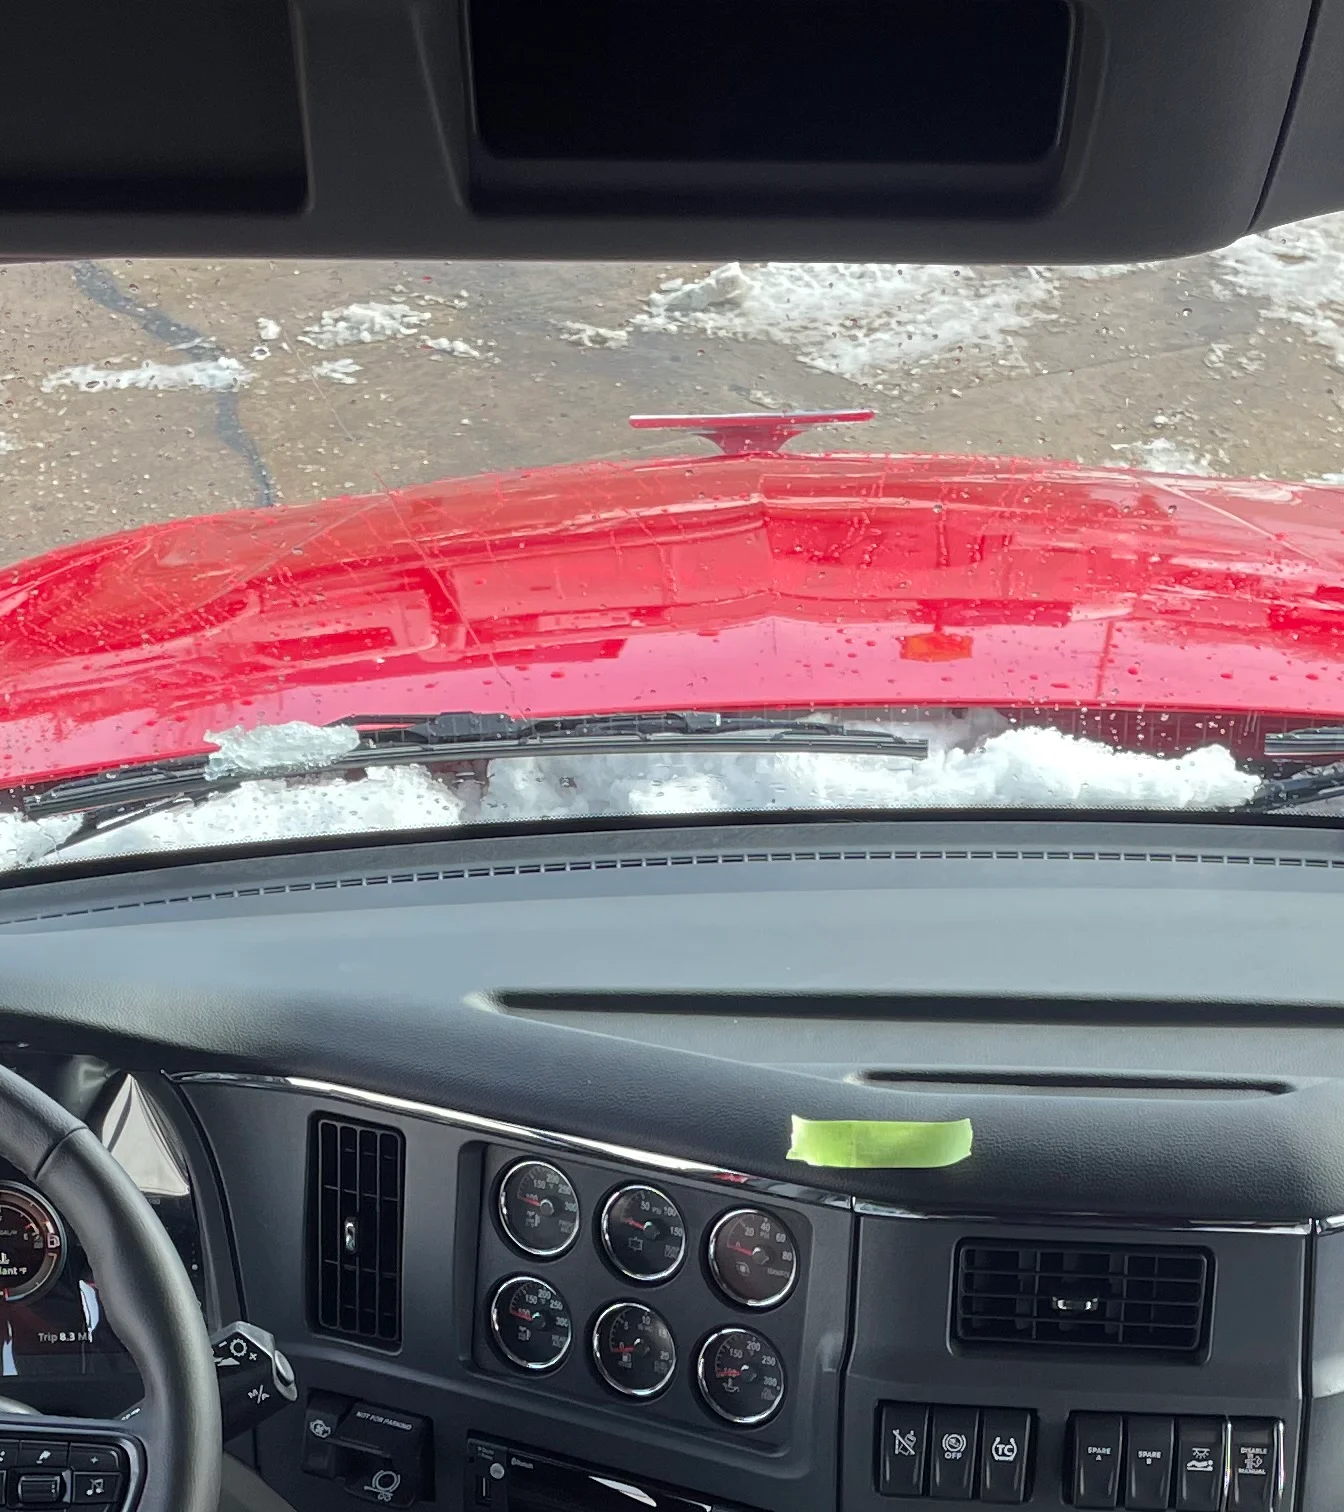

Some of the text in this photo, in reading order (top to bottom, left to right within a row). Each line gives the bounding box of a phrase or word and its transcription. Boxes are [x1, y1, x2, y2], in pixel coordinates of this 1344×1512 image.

[641, 1201, 650, 1211] 50
[745, 1227, 754, 1236] 20
[761, 1222, 770, 1232] 40
[776, 1233, 786, 1242] 60
[782, 1251, 792, 1261] 80
[550, 1300, 563, 1310] 250
[37, 1332, 58, 1342] Trip
[59, 1332, 76, 1341] 8.3
[762, 1355, 775, 1366] 250
[356, 1411, 412, 1431] NOT FOR PARKING
[997, 1443, 1014, 1457] TC
[1138, 1451, 1161, 1459] SPARE
[944, 1451, 963, 1460] OFF
